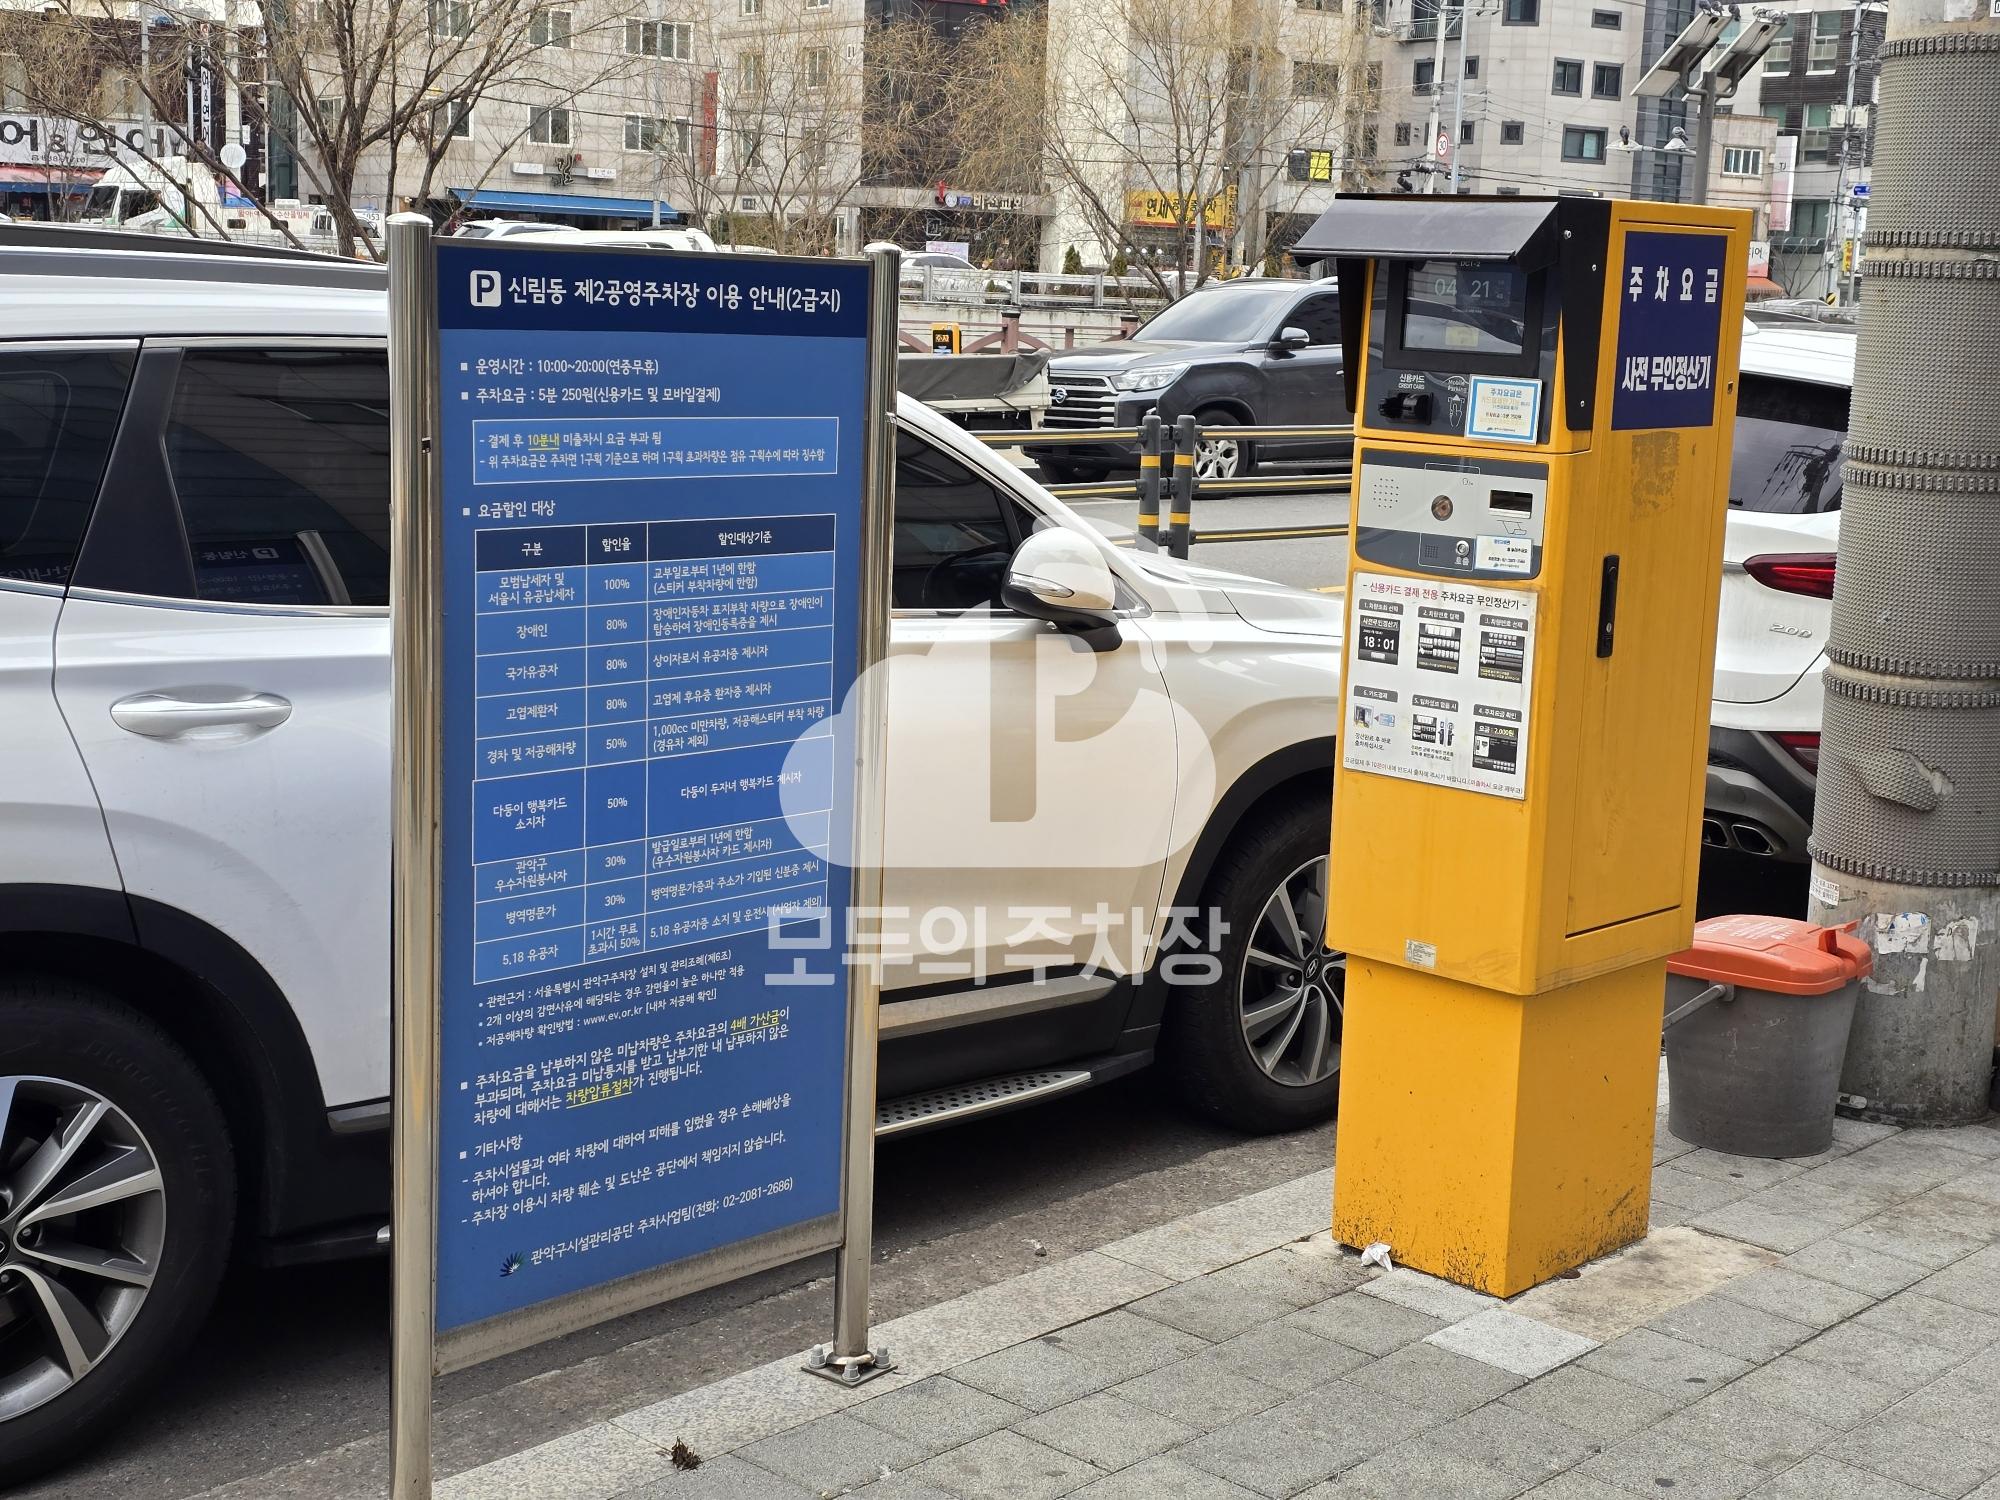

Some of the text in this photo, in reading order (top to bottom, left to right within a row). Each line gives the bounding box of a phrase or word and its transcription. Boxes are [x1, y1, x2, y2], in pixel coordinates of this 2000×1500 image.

[507, 276, 841, 314] 신림동 제2공영주차장 이용 안내(2급지)
[475, 357, 659, 376] 운영시간 10:00~20:00(연중무휴)
[1622, 355, 1712, 391] 사전 무인정산기
[1399, 373, 1425, 383] 신용카드
[475, 386, 721, 405] 주차요금 5분 250원(신용카드 및 모바일결제)
[487, 431, 662, 449] 결제 후 10분내 미출차시 요금 부과 됨
[477, 499, 557, 519] 요금할인 대상
[601, 536, 632, 553] 할인율
[717, 530, 773, 546] 할인대상기준
[521, 541, 544, 557] 구분
[498, 571, 565, 590] 모범납세자 및
[604, 578, 631, 591] 100%
[487, 587, 576, 606] 서울시 유공납세자
[1370, 582, 1520, 610] 신용카드 결제 전용 주차요금 무인정산기
[516, 623, 548, 640] 장애인
[606, 618, 628, 631] 80%
[605, 658, 628, 671] 80%
[652, 644, 769, 668] 상이자로서 유공자증 제시자
[505, 663, 559, 681] 국가유공자
[652, 681, 772, 707] 고엽제 후유증 환자증 제시자
[505, 703, 559, 720] 고엽제환자
[605, 698, 628, 711] 80%
[487, 740, 577, 765] 경차 및 저공해차량
[605, 737, 628, 750] 50%
[653, 733, 709, 753] (경유차 제외)
[492, 796, 568, 818] 다둥이 행복카드
[607, 797, 628, 809] 50%
[514, 814, 547, 830] 소지자
[604, 855, 627, 868] 30%
[651, 837, 773, 869] (우수자원봉사자 카드 제시자)
[513, 854, 548, 875] 관악구
[494, 869, 568, 893] 우수자원봉사자
[604, 894, 626, 907] 30%
[505, 904, 557, 925] 병역명문가
[591, 922, 639, 941] 1시간 무료
[502, 944, 560, 966] 5.18 유공자
[586, 936, 641, 956] 초과시 50%
[474, 1006, 790, 1090] 주차요금을 납부하지 않은 미납차량은 주차요금의 4배 가산금이
[473, 1060, 703, 1126] 차량에 대해서는 차량압류절차가 진행됩니다.
[472, 1093, 792, 1186] 주차시설물과 여타 차량에 대하여 피해를 입혔을 경우 손해배상을
[474, 1133, 524, 1158] 기타사항
[471, 1171, 551, 1204] 하셔야 합니다.
[530, 1177, 793, 1266] 관악구시설관리공단 주차사업팀(전화: 02-2081-2686)
